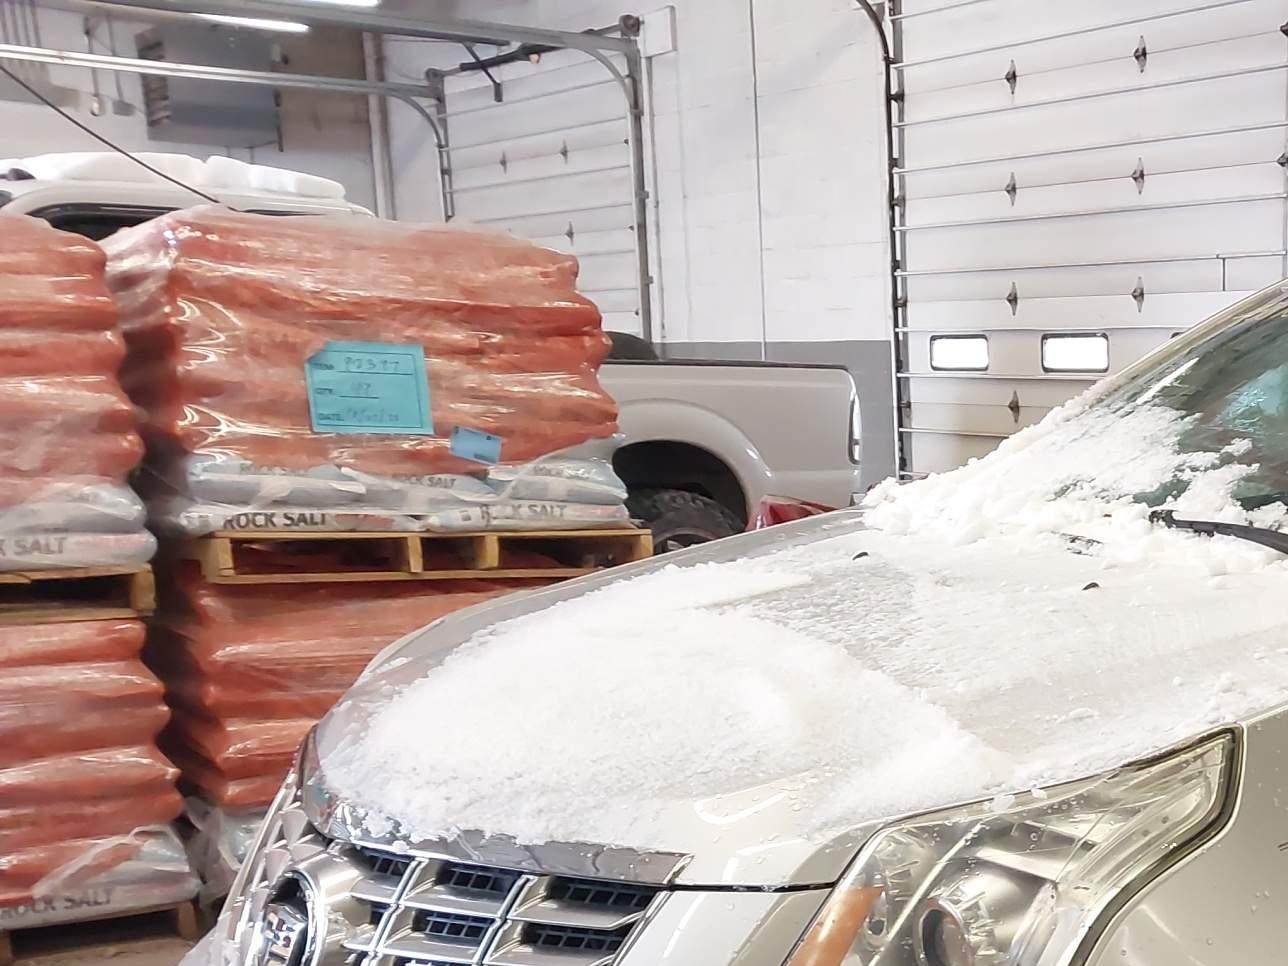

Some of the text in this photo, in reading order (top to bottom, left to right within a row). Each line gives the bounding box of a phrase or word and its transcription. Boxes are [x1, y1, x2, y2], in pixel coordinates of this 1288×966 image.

[427, 476, 457, 488] SALT
[527, 504, 568, 517] SALT
[223, 512, 327, 530] ROCK SALT
[14, 536, 68, 556] SALT
[64, 886, 114, 910] SALT
